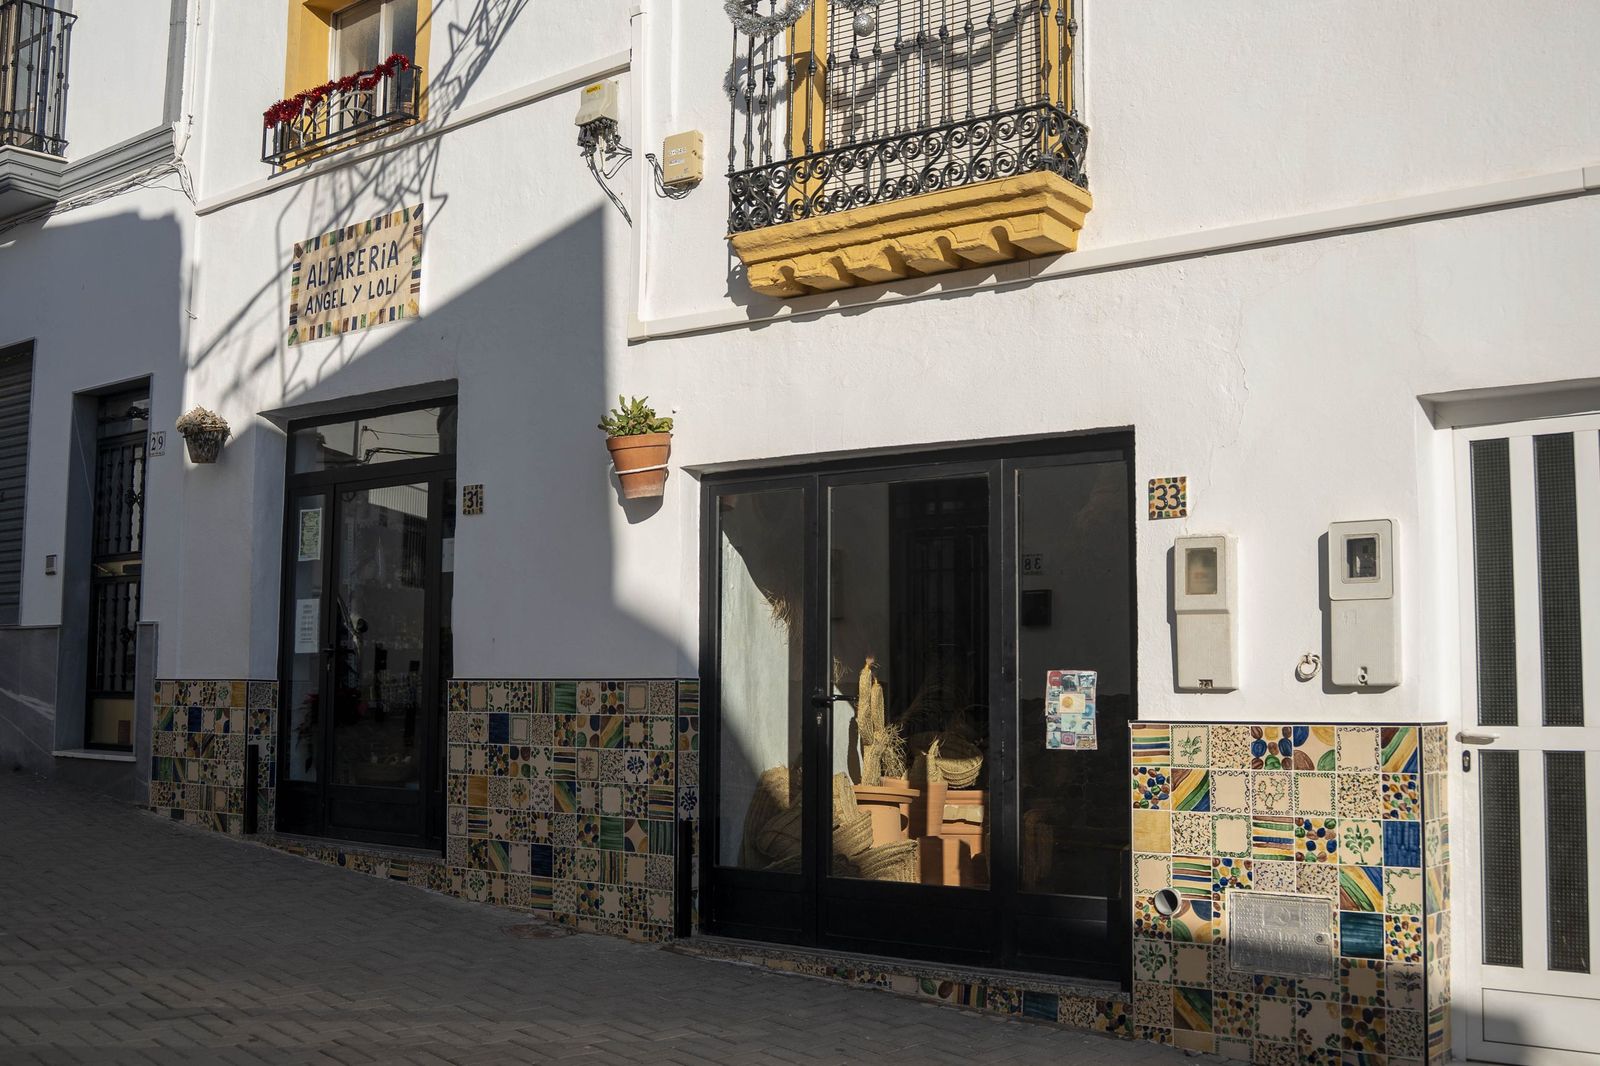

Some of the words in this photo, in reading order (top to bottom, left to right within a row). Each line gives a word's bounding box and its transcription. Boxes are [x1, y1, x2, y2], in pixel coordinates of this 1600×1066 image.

[304, 288, 347, 316] ANGEL
[352, 284, 362, 303] Y
[151, 435, 164, 451] 29
[466, 489, 479, 509] 31
[1155, 484, 1181, 511] 33
